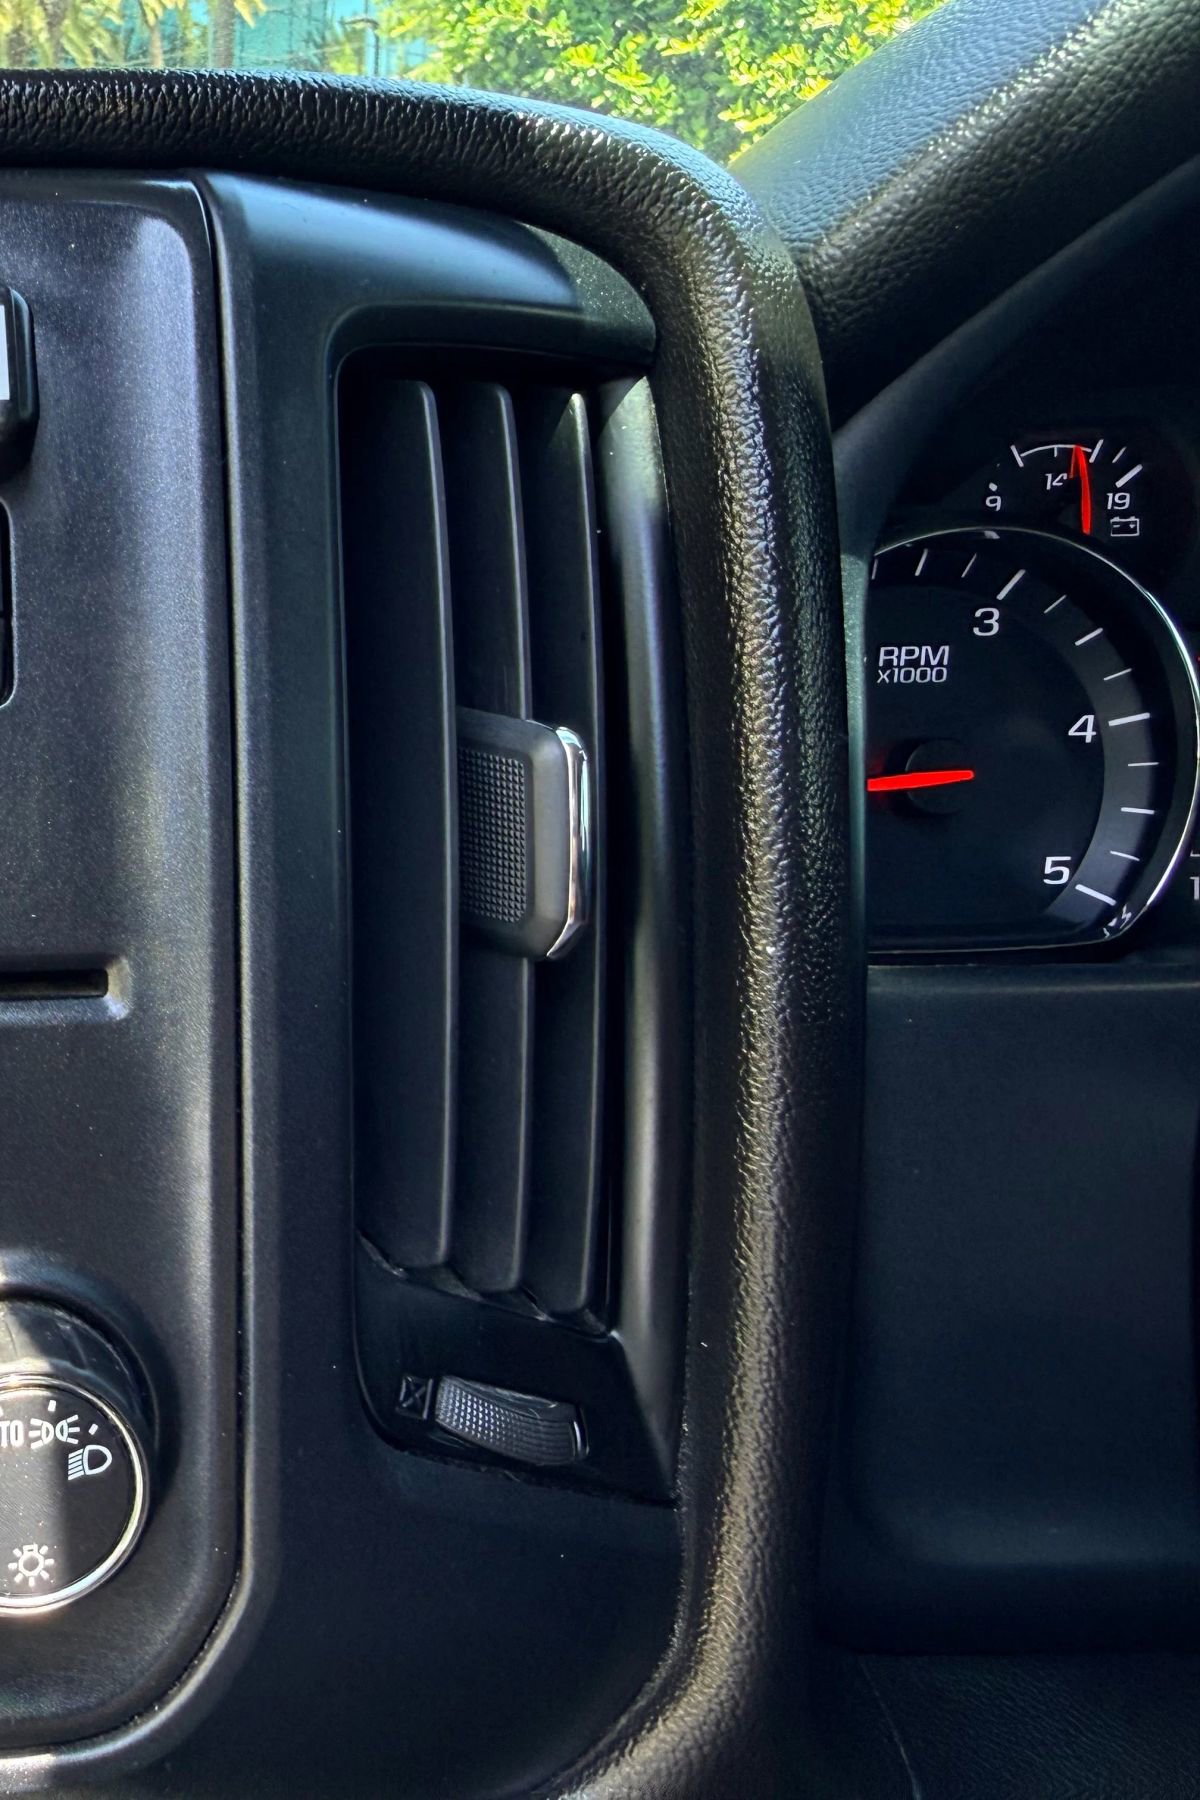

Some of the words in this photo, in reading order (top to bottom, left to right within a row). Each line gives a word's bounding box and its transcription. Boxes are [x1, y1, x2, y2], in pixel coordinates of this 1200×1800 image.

[985, 495, 1002, 512] 9
[1106, 492, 1131, 511] 19
[972, 607, 1000, 637] 3
[878, 645, 950, 667] RPM
[876, 667, 948, 684] x1000
[1067, 714, 1097, 744] 4
[1043, 855, 1072, 885] 5
